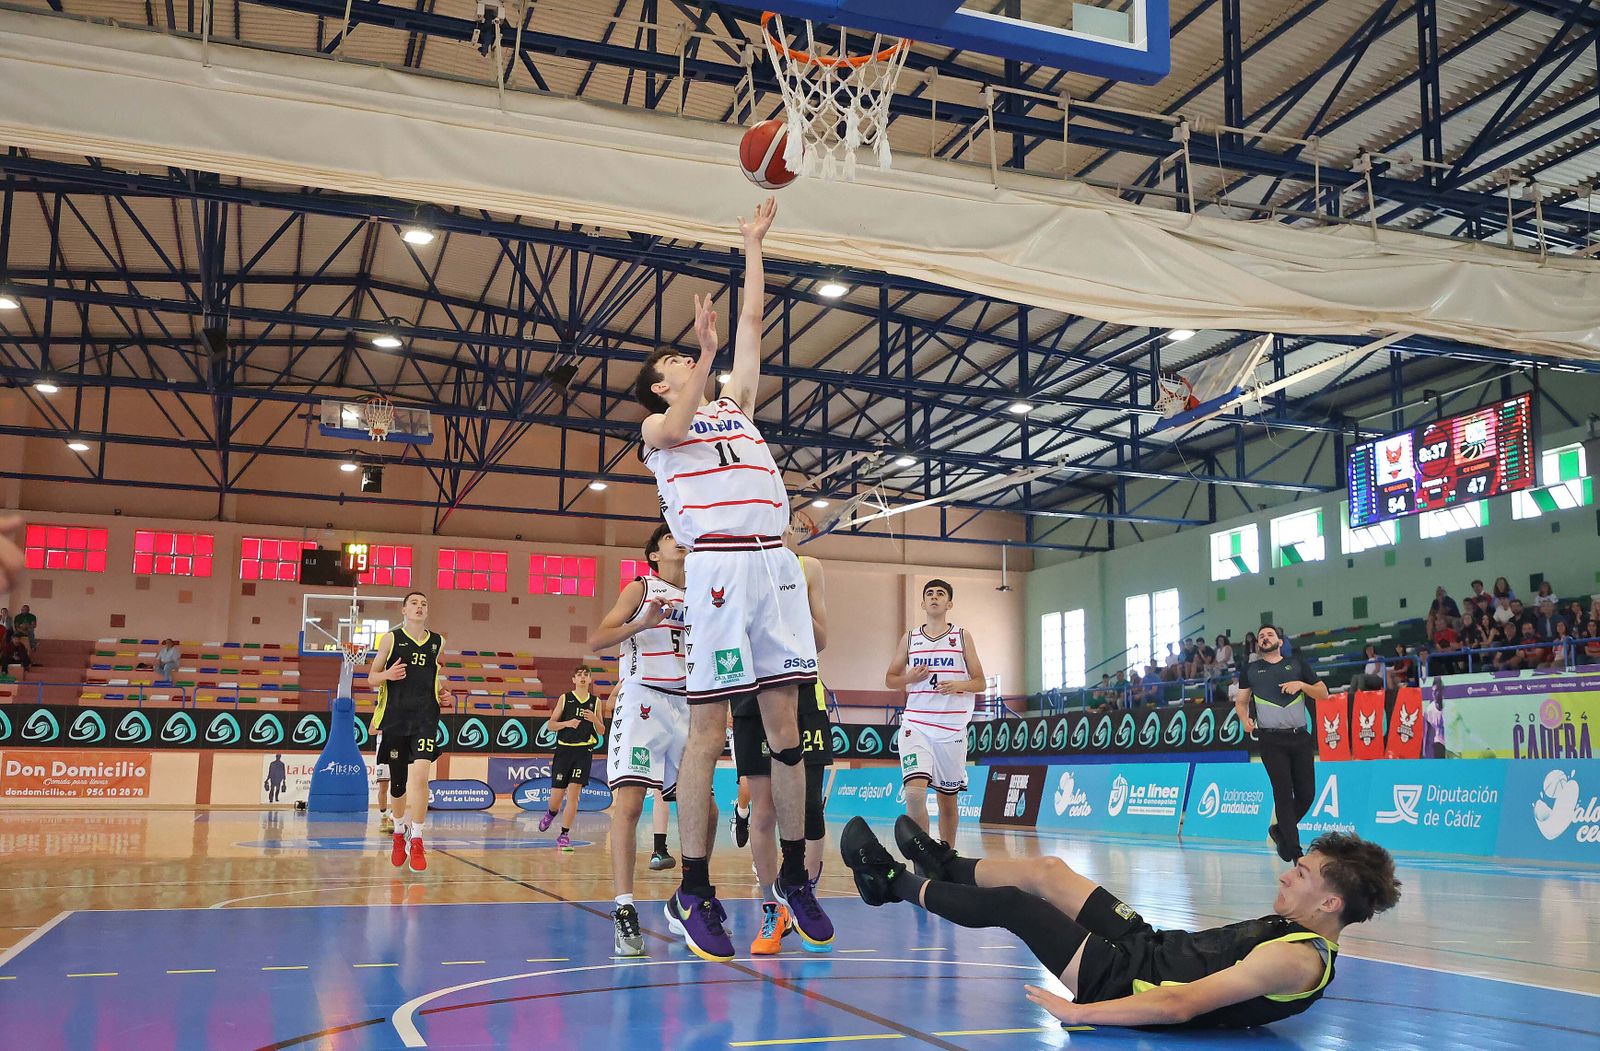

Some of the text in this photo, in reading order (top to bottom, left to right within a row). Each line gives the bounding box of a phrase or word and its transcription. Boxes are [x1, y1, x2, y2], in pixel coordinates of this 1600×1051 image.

[690, 419, 745, 434] ULEVA
[715, 441, 741, 467] 11
[1418, 441, 1448, 463] 8:37
[1466, 475, 1487, 495] 47
[1388, 495, 1407, 514] 54
[349, 554, 367, 571] 19
[779, 583, 796, 592] vive
[671, 629, 681, 654] 5
[411, 652, 427, 666] 35
[913, 657, 955, 668] PULEVA
[929, 673, 939, 690] 4
[417, 738, 435, 752] 35
[803, 729, 824, 752] 24
[6, 760, 146, 778] Don Domicilio
[287, 765, 314, 775] La Le
[508, 766, 551, 780] MGS
[571, 768, 582, 778] 12
[5, 788, 144, 797] dondomicilio.es 956 10 28 78
[581, 789, 611, 797] DEPORTES
[858, 782, 885, 802] cajasur
[1129, 783, 1179, 799] La línea
[1222, 788, 1264, 802] baloncesto
[1426, 784, 1498, 806] Diputación
[1313, 822, 1322, 831] de
[1423, 809, 1481, 828] de Cádiz
